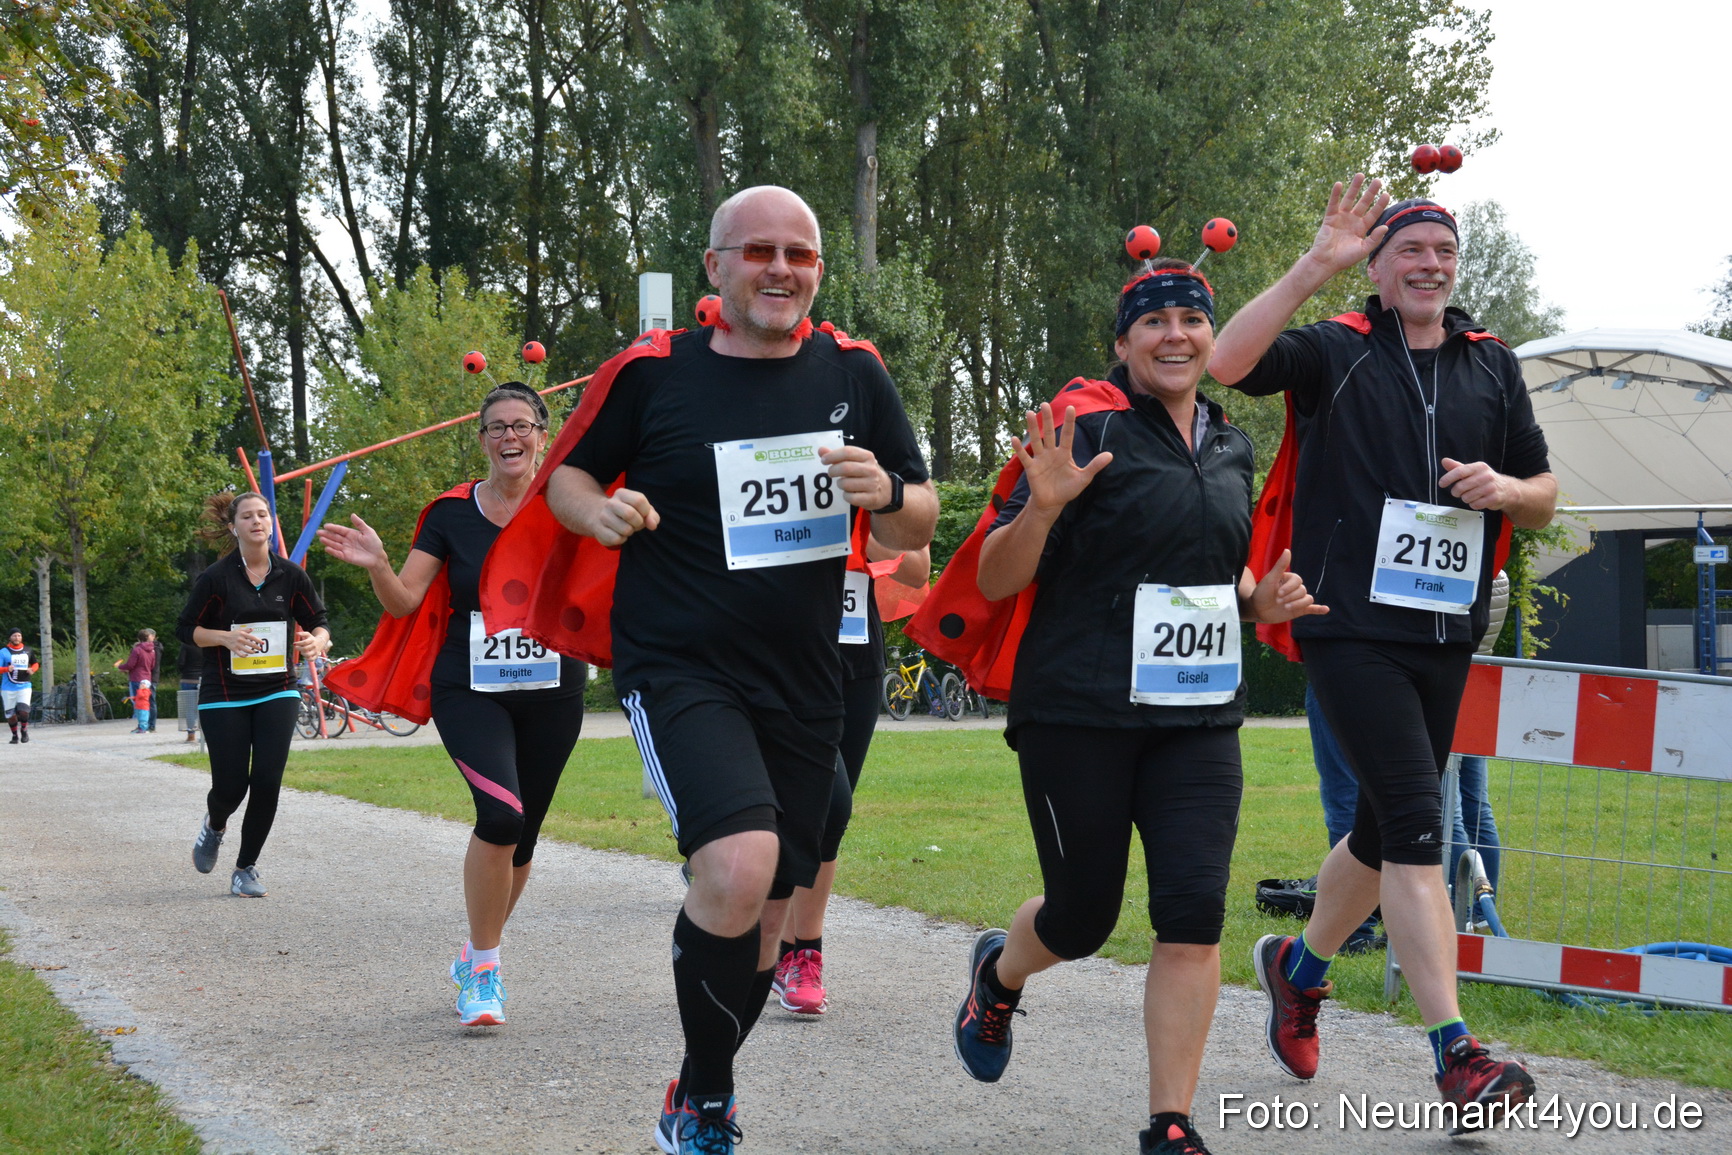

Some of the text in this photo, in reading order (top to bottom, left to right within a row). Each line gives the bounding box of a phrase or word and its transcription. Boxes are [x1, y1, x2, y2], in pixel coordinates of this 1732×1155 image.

[768, 446, 814, 460] BOCK
[740, 472, 833, 517] 2518
[774, 527, 812, 543] Ralph
[1393, 533, 1467, 572] 2139
[1414, 578, 1445, 593] Frank
[1153, 622, 1226, 657] 2041
[483, 636, 547, 660] 2155
[500, 668, 532, 679] Brigitte
[1177, 671, 1209, 684] Gisela
